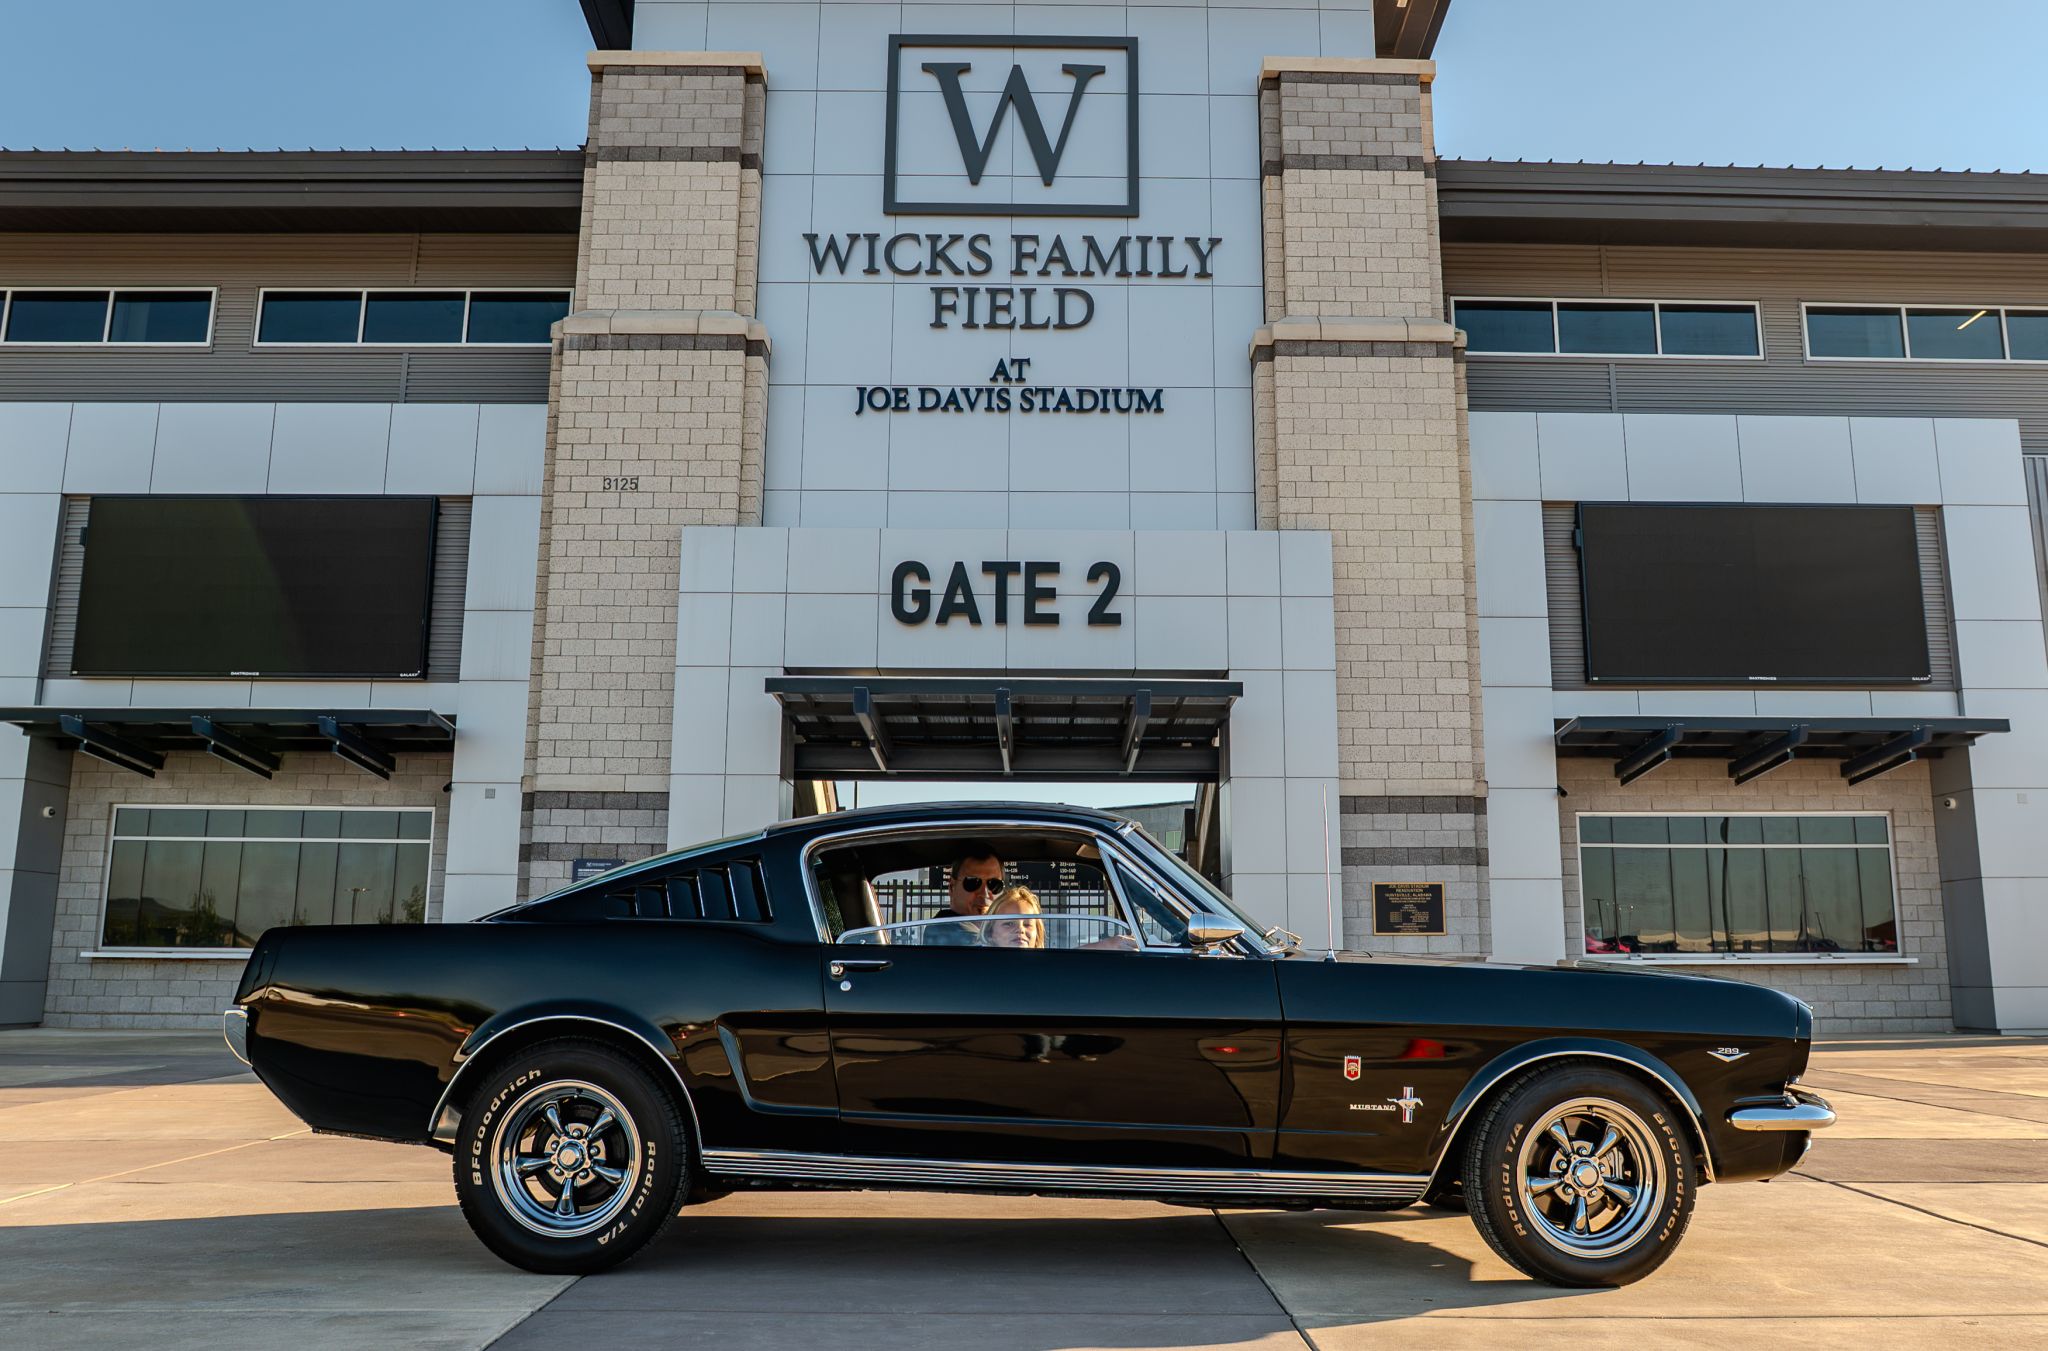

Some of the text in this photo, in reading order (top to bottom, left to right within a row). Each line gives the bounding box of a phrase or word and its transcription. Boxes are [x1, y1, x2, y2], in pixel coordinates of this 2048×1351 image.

[921, 61, 1106, 187] W
[802, 232, 1223, 279] WICKS FAMILY
[929, 286, 1096, 330] FIELD
[989, 357, 1031, 383] AT
[855, 386, 1165, 416] JOE DAVIS STADIUM
[603, 477, 639, 491] 3125
[890, 560, 1122, 626] GATE 2
[1717, 1047, 1740, 1055] 289
[471, 1068, 542, 1186] BFGoodrich
[1349, 1104, 1397, 1112] MUSTANG
[597, 1141, 656, 1246] Radial T/A
[1501, 1122, 1528, 1237] Radial T/A
[1652, 1112, 1686, 1242] BFGoodrich
